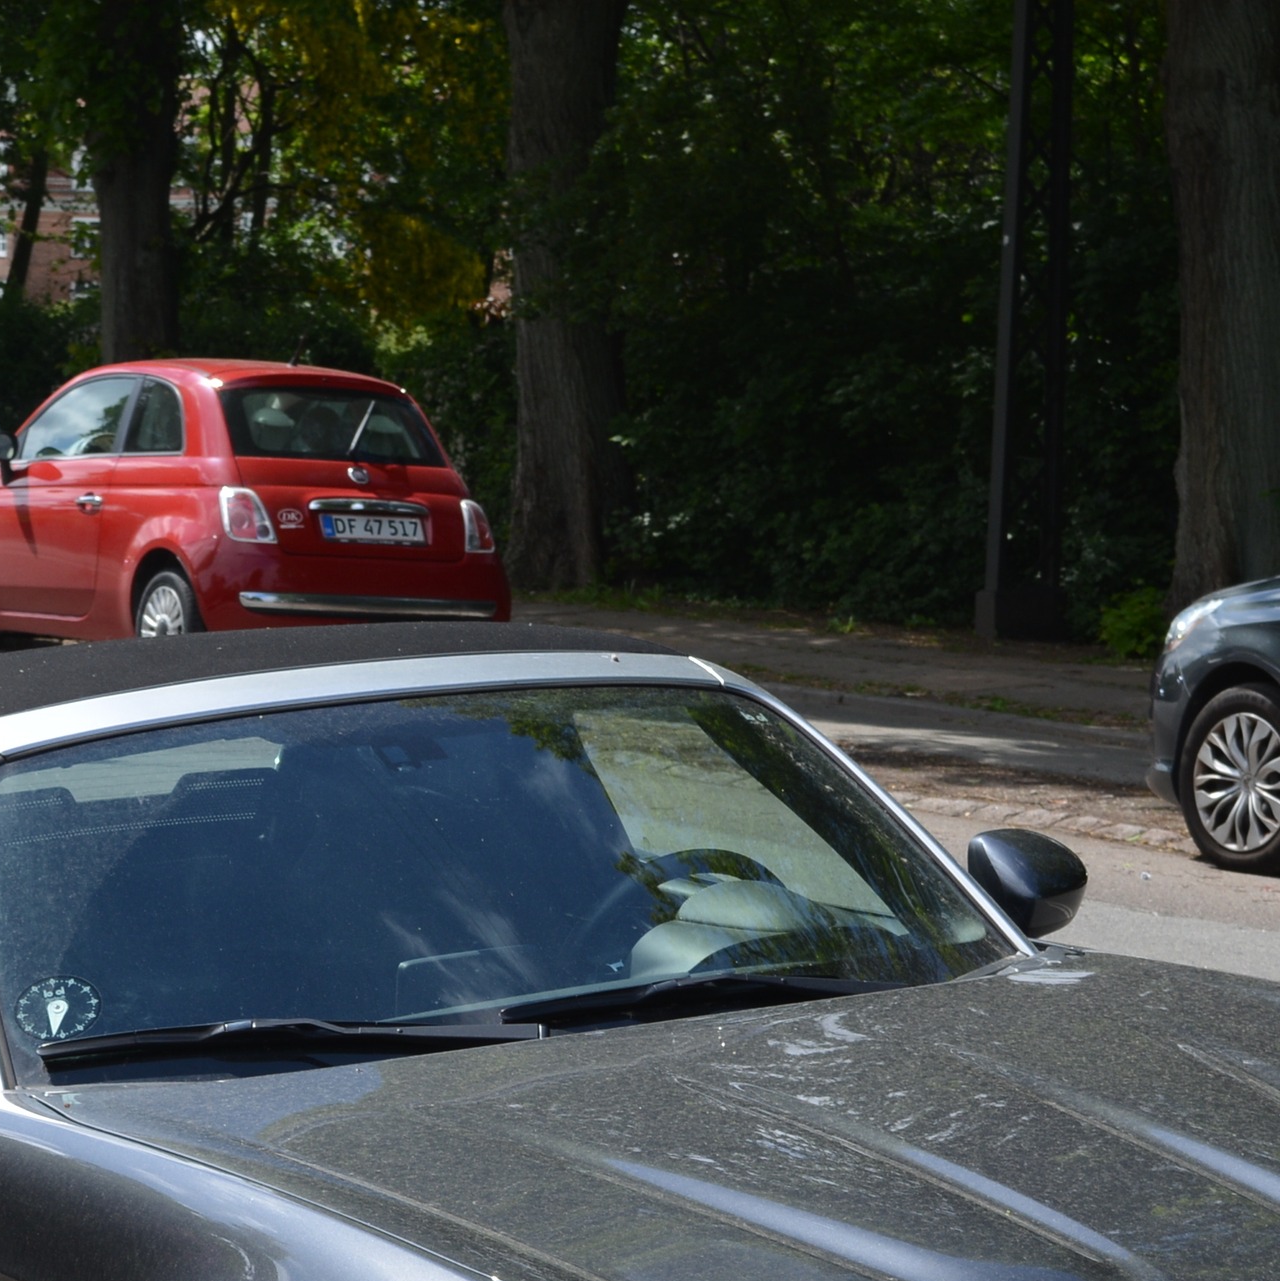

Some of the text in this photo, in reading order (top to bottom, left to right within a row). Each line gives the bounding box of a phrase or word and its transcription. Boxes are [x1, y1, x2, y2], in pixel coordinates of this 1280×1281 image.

[333, 518, 355, 534] DF
[363, 519, 383, 535] 47
[388, 520, 418, 537] 517
